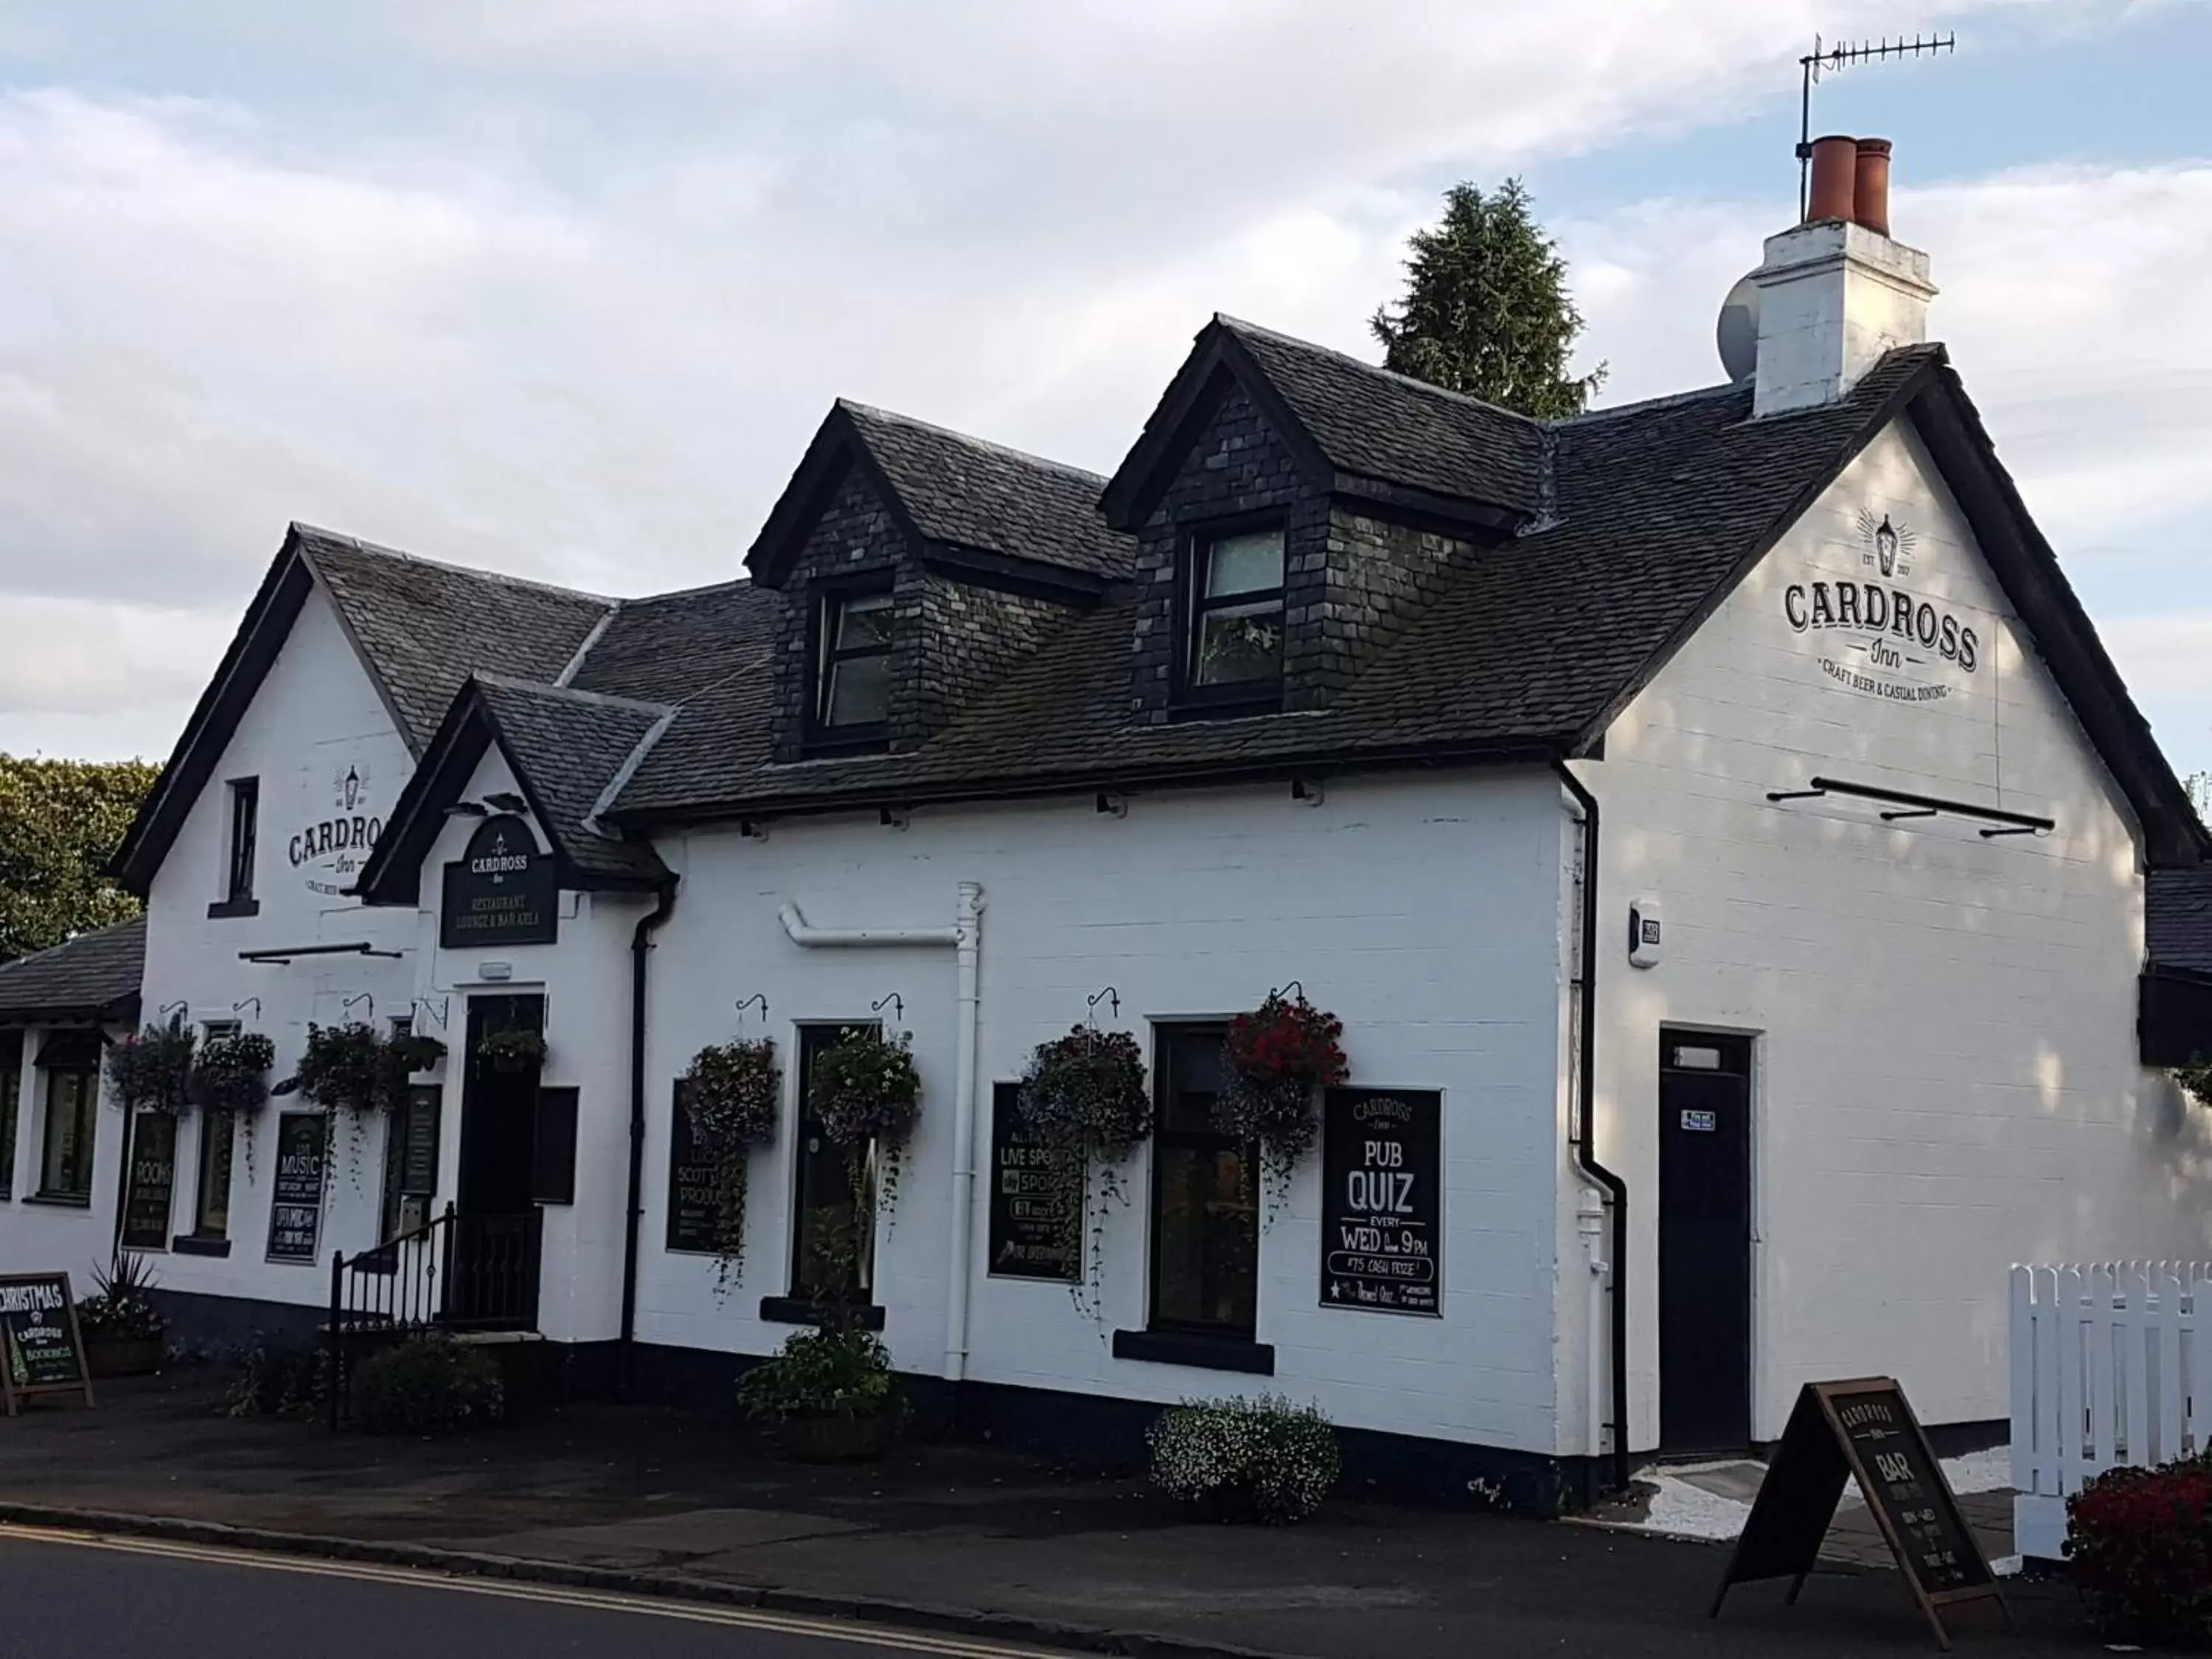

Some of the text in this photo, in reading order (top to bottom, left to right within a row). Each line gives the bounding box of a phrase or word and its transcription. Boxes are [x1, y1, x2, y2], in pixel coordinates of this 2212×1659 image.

[1784, 581, 1979, 672] CARDROSS
[1871, 638, 1902, 669] Inn
[1823, 659, 1947, 701] CRAFT BEER & CASUAL DINING
[289, 816, 381, 869] CARDRO
[472, 855, 527, 873] CARDROSS
[1354, 1098, 1412, 1121] CARDROSS
[281, 1155, 320, 1175] MUSIC
[1001, 1147, 1051, 1166] LIVE SPO
[1365, 1141, 1402, 1167] PUB
[1348, 1171, 1414, 1213] QUIZ
[1370, 1217, 1400, 1228] EVERY
[1340, 1226, 1380, 1252] WED
[1368, 1258, 1389, 1274] CASH
[0, 1284, 63, 1312] CHRISTMAS
[1876, 1452, 1914, 1482] BAR
